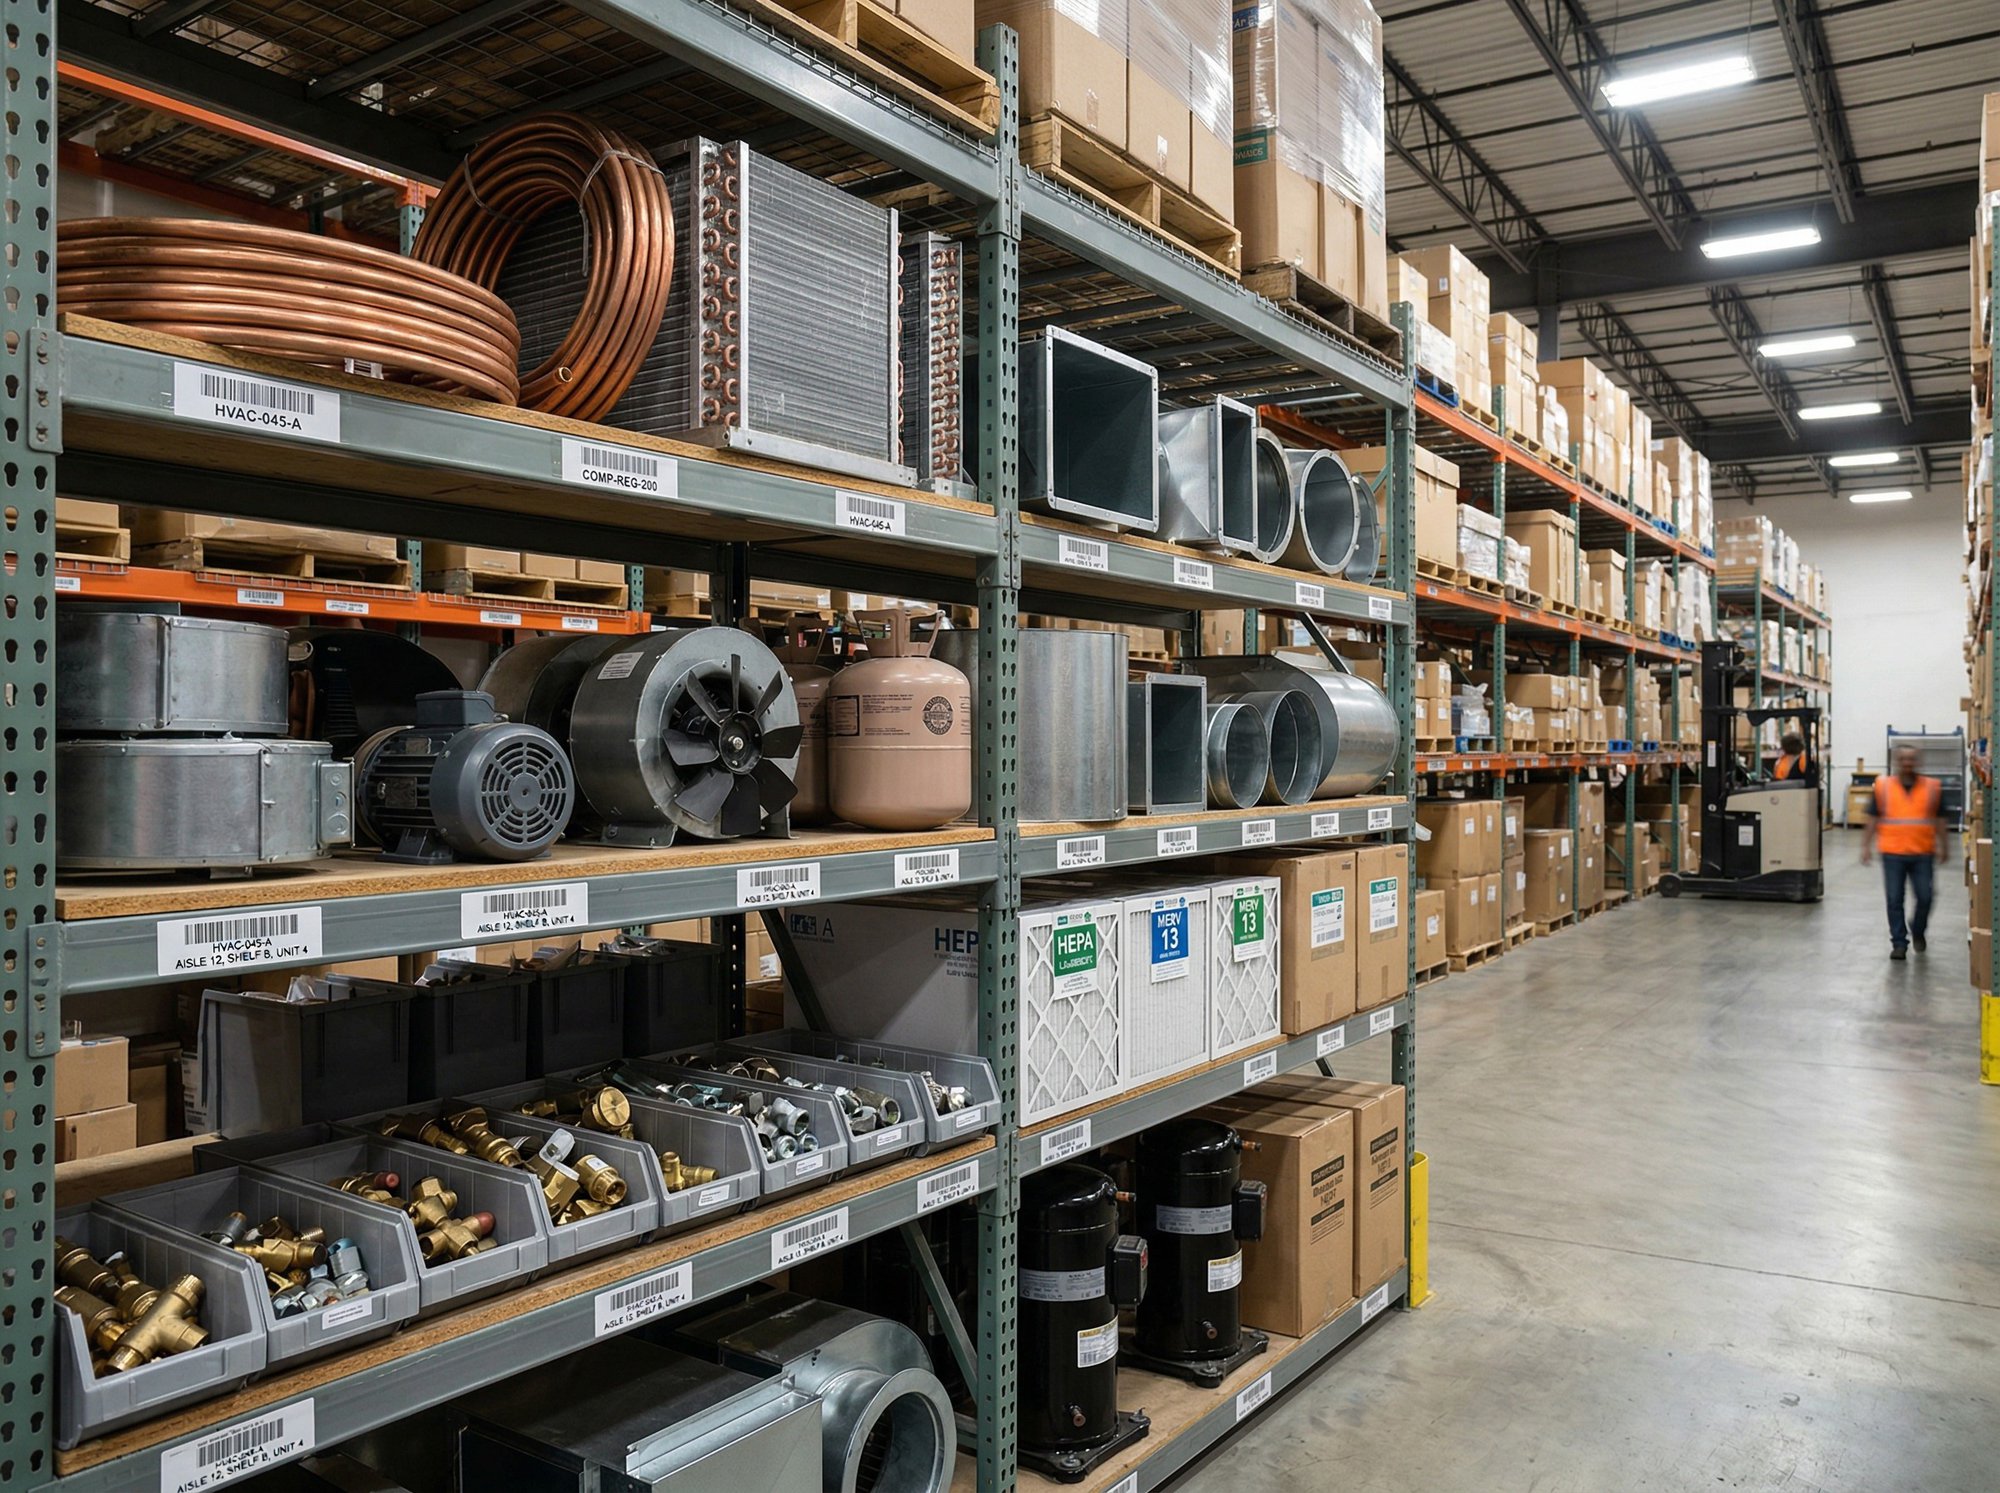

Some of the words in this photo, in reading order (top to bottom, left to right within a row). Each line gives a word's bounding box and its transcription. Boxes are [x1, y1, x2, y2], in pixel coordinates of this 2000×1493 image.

[215, 404, 302, 430] HVAC-045-A
[582, 469, 658, 492] COMP-REG-200
[1239, 899, 1260, 913] MERV
[1157, 911, 1182, 928] MERV
[1242, 912, 1256, 933] 13
[212, 938, 272, 953] HVAC-045-A
[1058, 931, 1093, 955] HEPA
[1162, 927, 1178, 950] 13
[175, 956, 207, 969] AISLE
[211, 955, 224, 966] 12,
[227, 950, 261, 963] SHELF
[276, 946, 300, 957] UNIT
[177, 1475, 208, 1493] AISLE
[227, 1458, 260, 1475] SHELF
[273, 1442, 295, 1457] UNIT
[298, 1439, 304, 1447] 4
